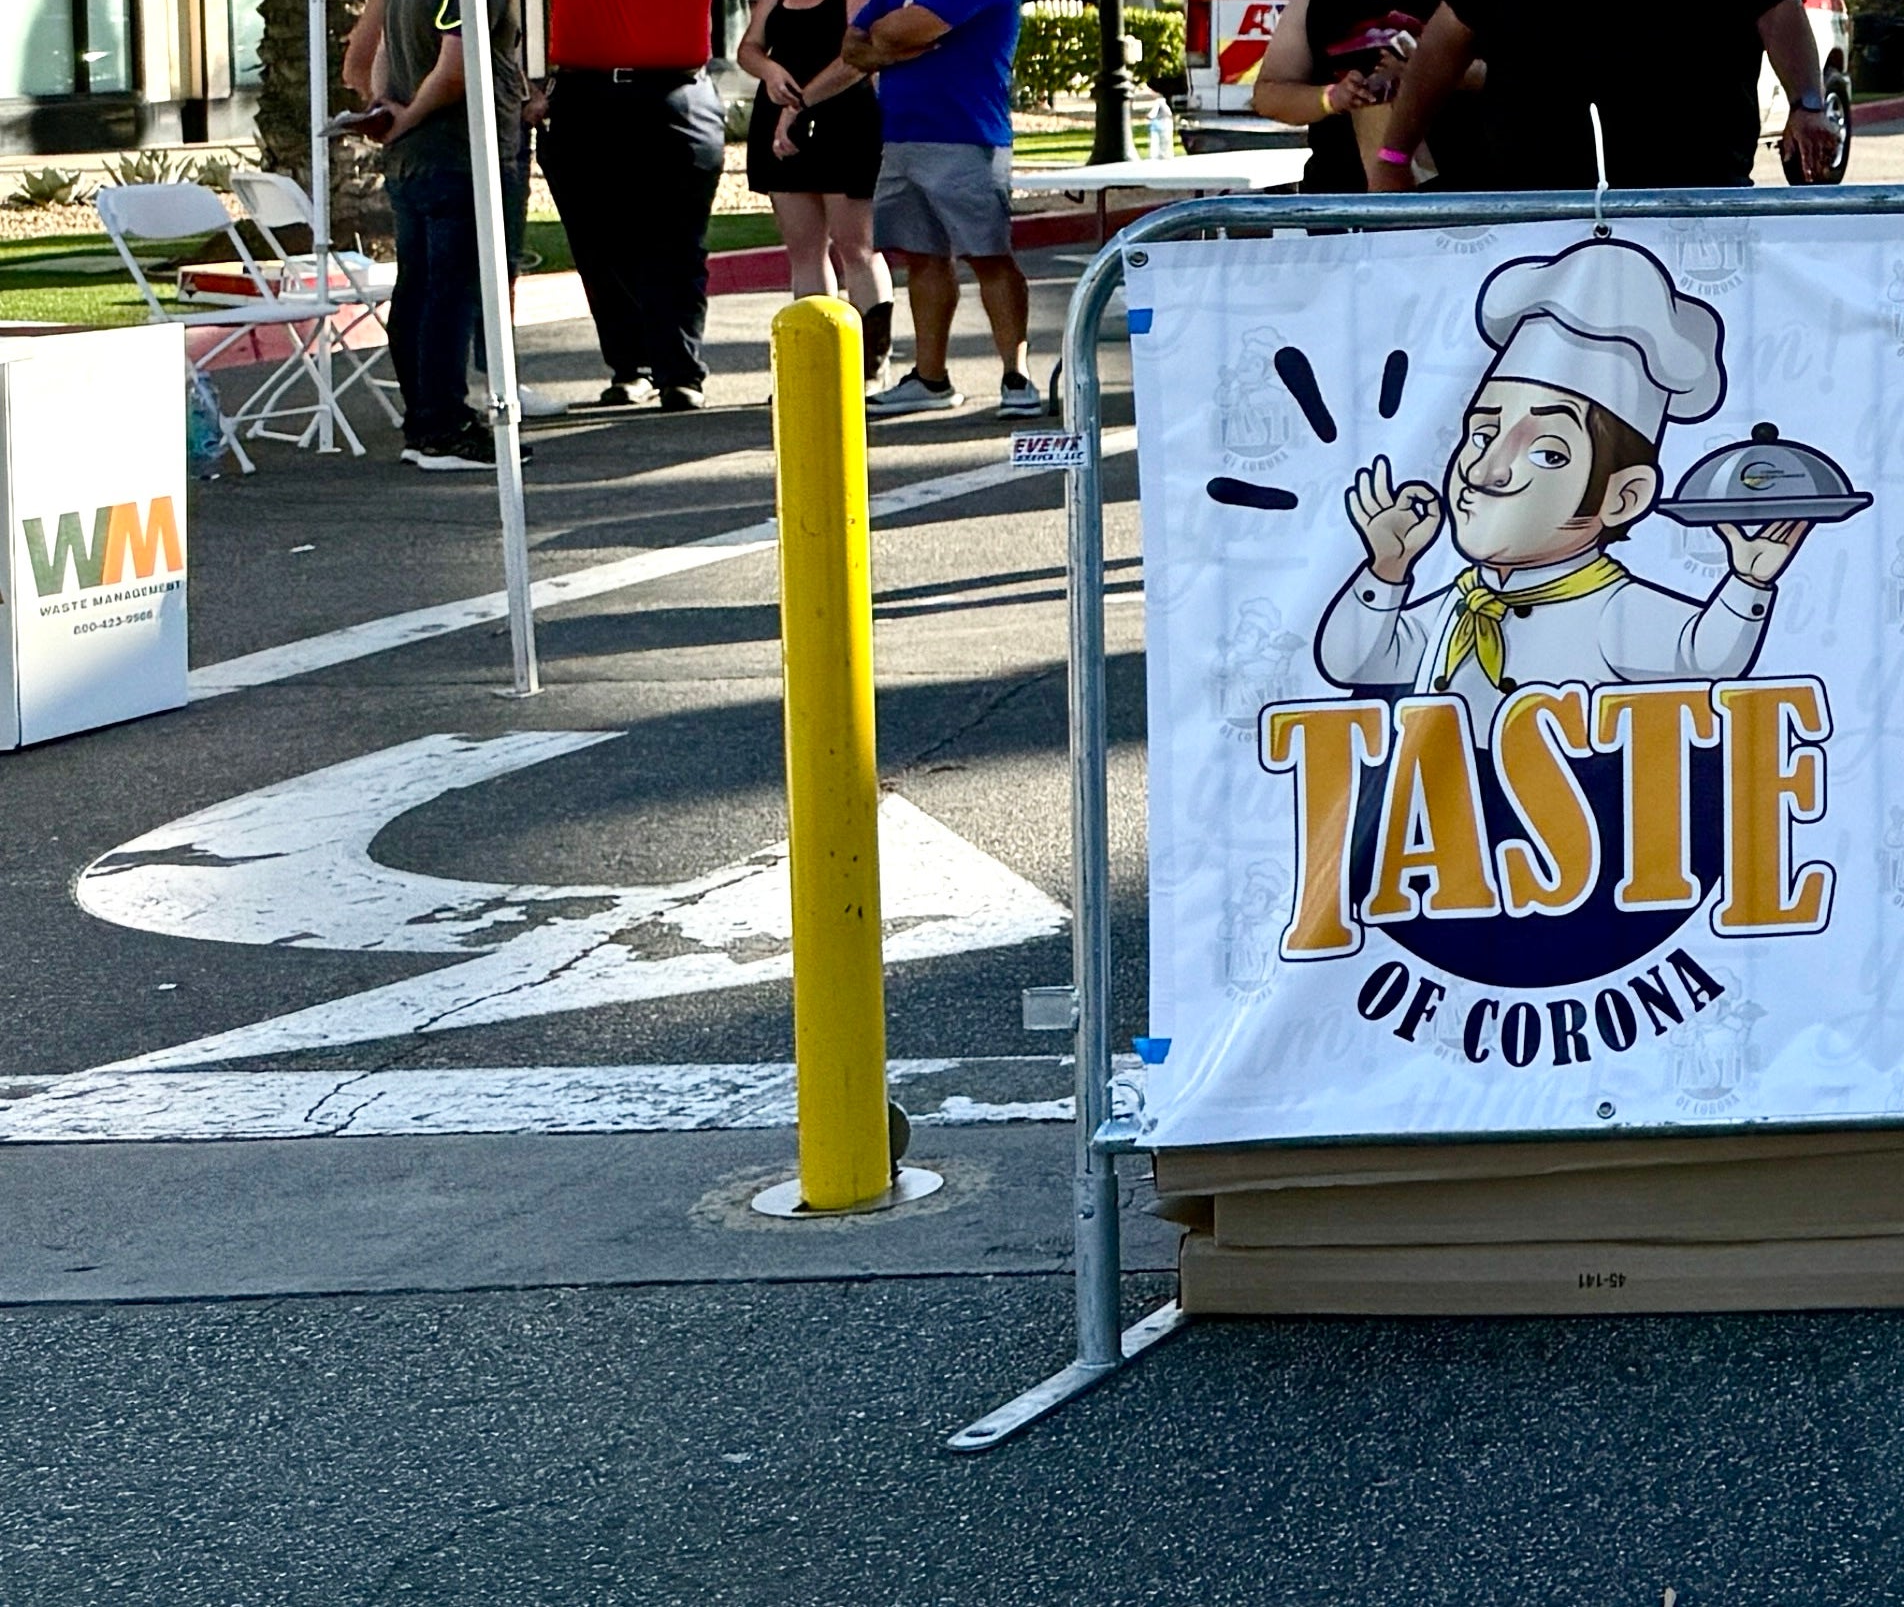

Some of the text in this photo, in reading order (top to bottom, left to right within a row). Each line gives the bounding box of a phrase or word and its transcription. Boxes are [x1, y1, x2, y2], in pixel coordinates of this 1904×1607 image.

[22, 496, 184, 597] WM
[40, 599, 87, 617] WASTE
[1258, 675, 1836, 962] TASTE
[1356, 947, 1726, 1068] OF CORONA
[1578, 1272, 1627, 1289] 45-141
